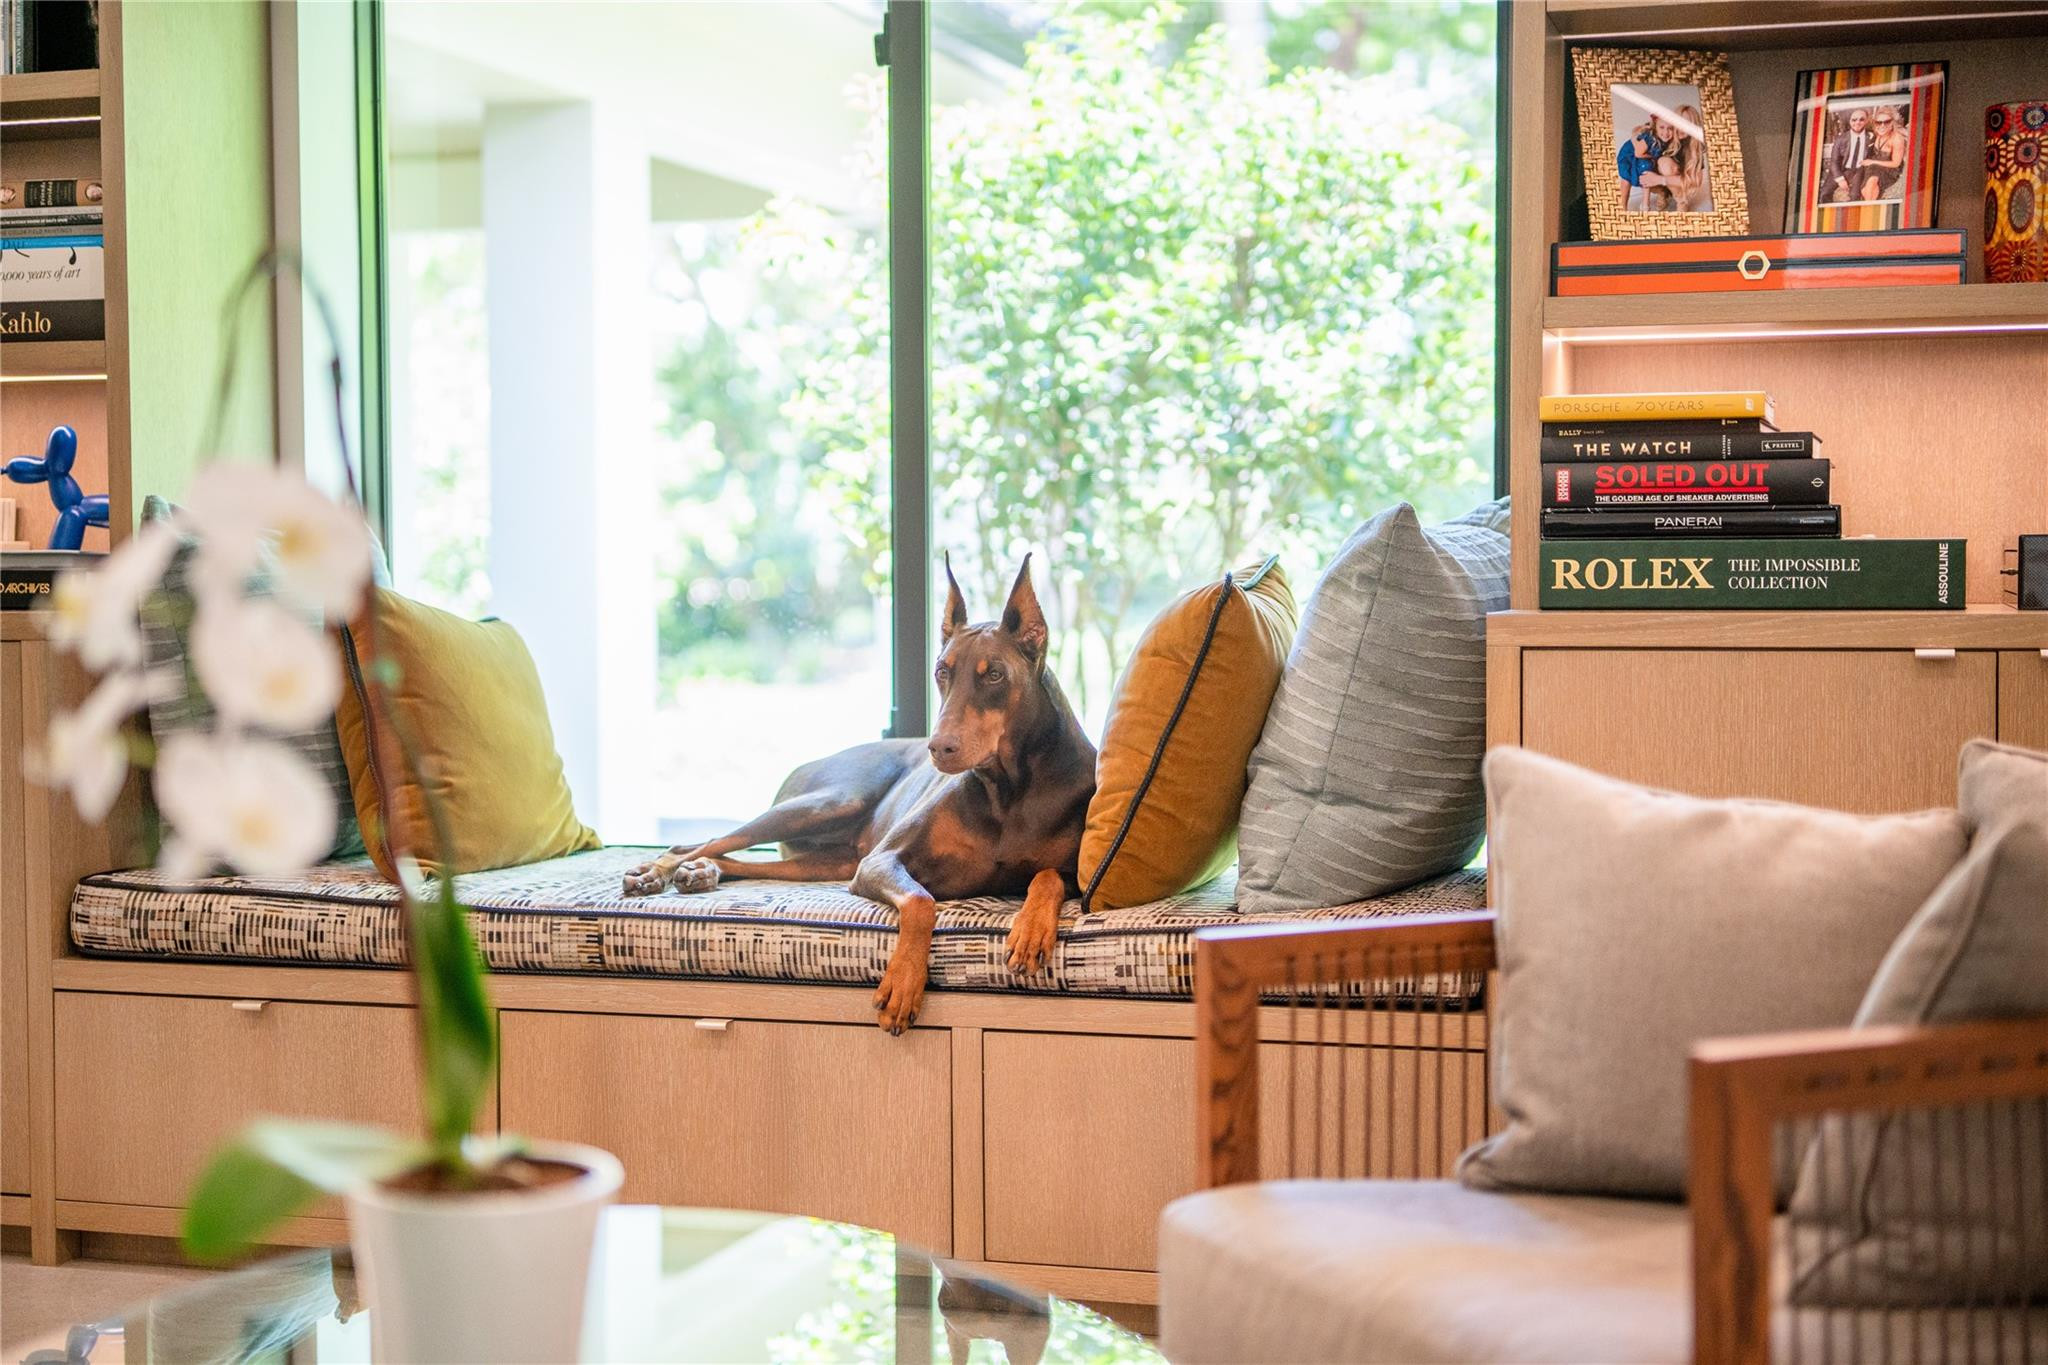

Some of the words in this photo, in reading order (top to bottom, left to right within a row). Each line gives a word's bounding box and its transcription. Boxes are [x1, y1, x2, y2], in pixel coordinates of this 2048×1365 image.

[26, 269, 52, 283] years
[54, 266, 65, 282] of
[64, 268, 81, 279] art
[1554, 402, 1621, 413] PORSCHE
[1558, 429, 1582, 437] BALLY
[1573, 443, 1611, 456] THE
[1620, 441, 1691, 455] WATCH
[1595, 464, 1696, 488] SOLED
[1705, 463, 1770, 487] OUT
[1716, 493, 1769, 501] ADVERTISING
[1654, 516, 1722, 527] PANERAI
[1728, 559, 1761, 572] THE
[1765, 559, 1861, 572] IMPOSSIBLE
[1551, 558, 1715, 590] ROLEX
[1938, 543, 1948, 604] ASSOULINE
[4, 582, 50, 593] ARCHIVES
[1728, 576, 1829, 589] COLLECTION
